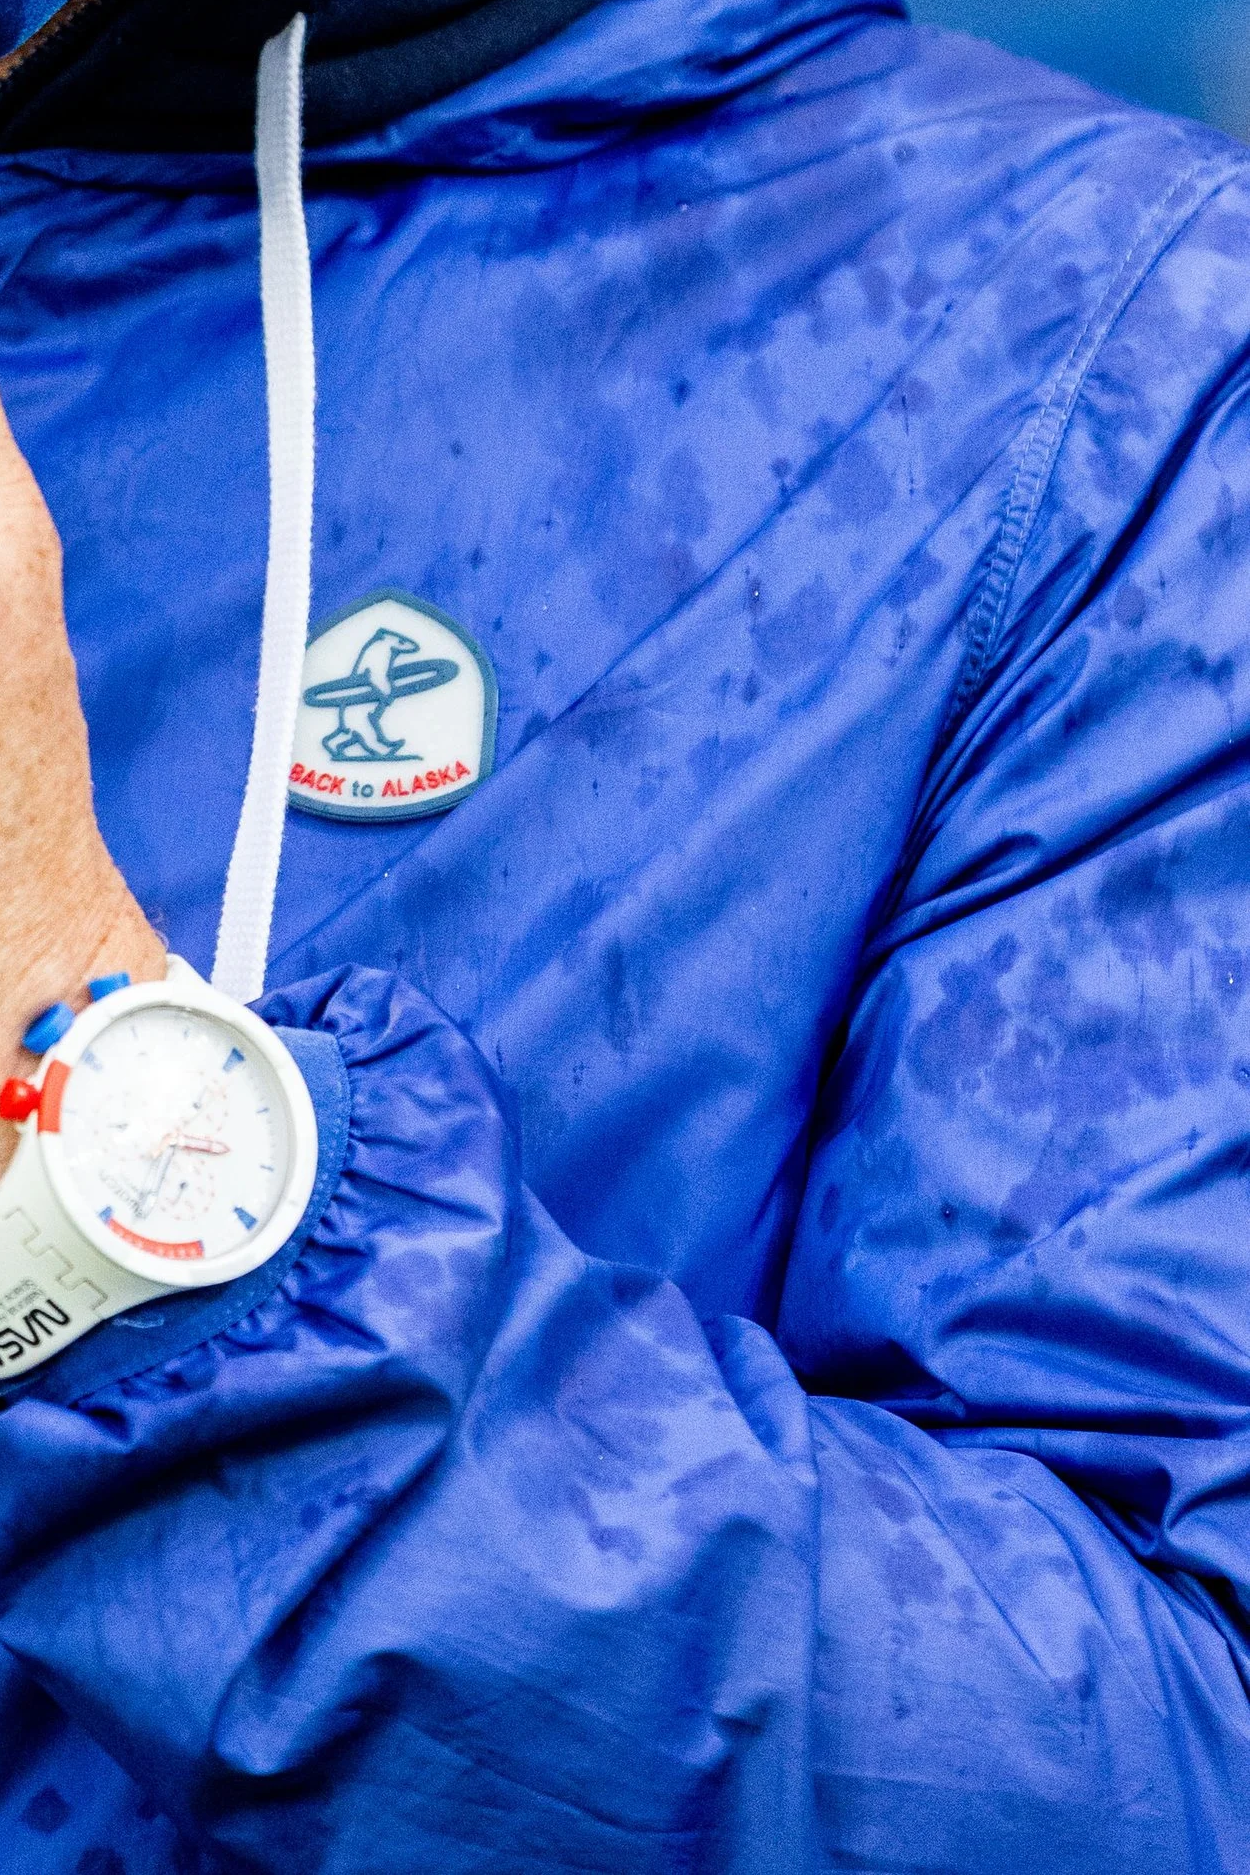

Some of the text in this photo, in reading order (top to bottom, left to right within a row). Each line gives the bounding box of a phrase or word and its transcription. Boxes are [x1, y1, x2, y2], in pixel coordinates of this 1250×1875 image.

[289, 760, 471, 798] BACK to ALASKA
